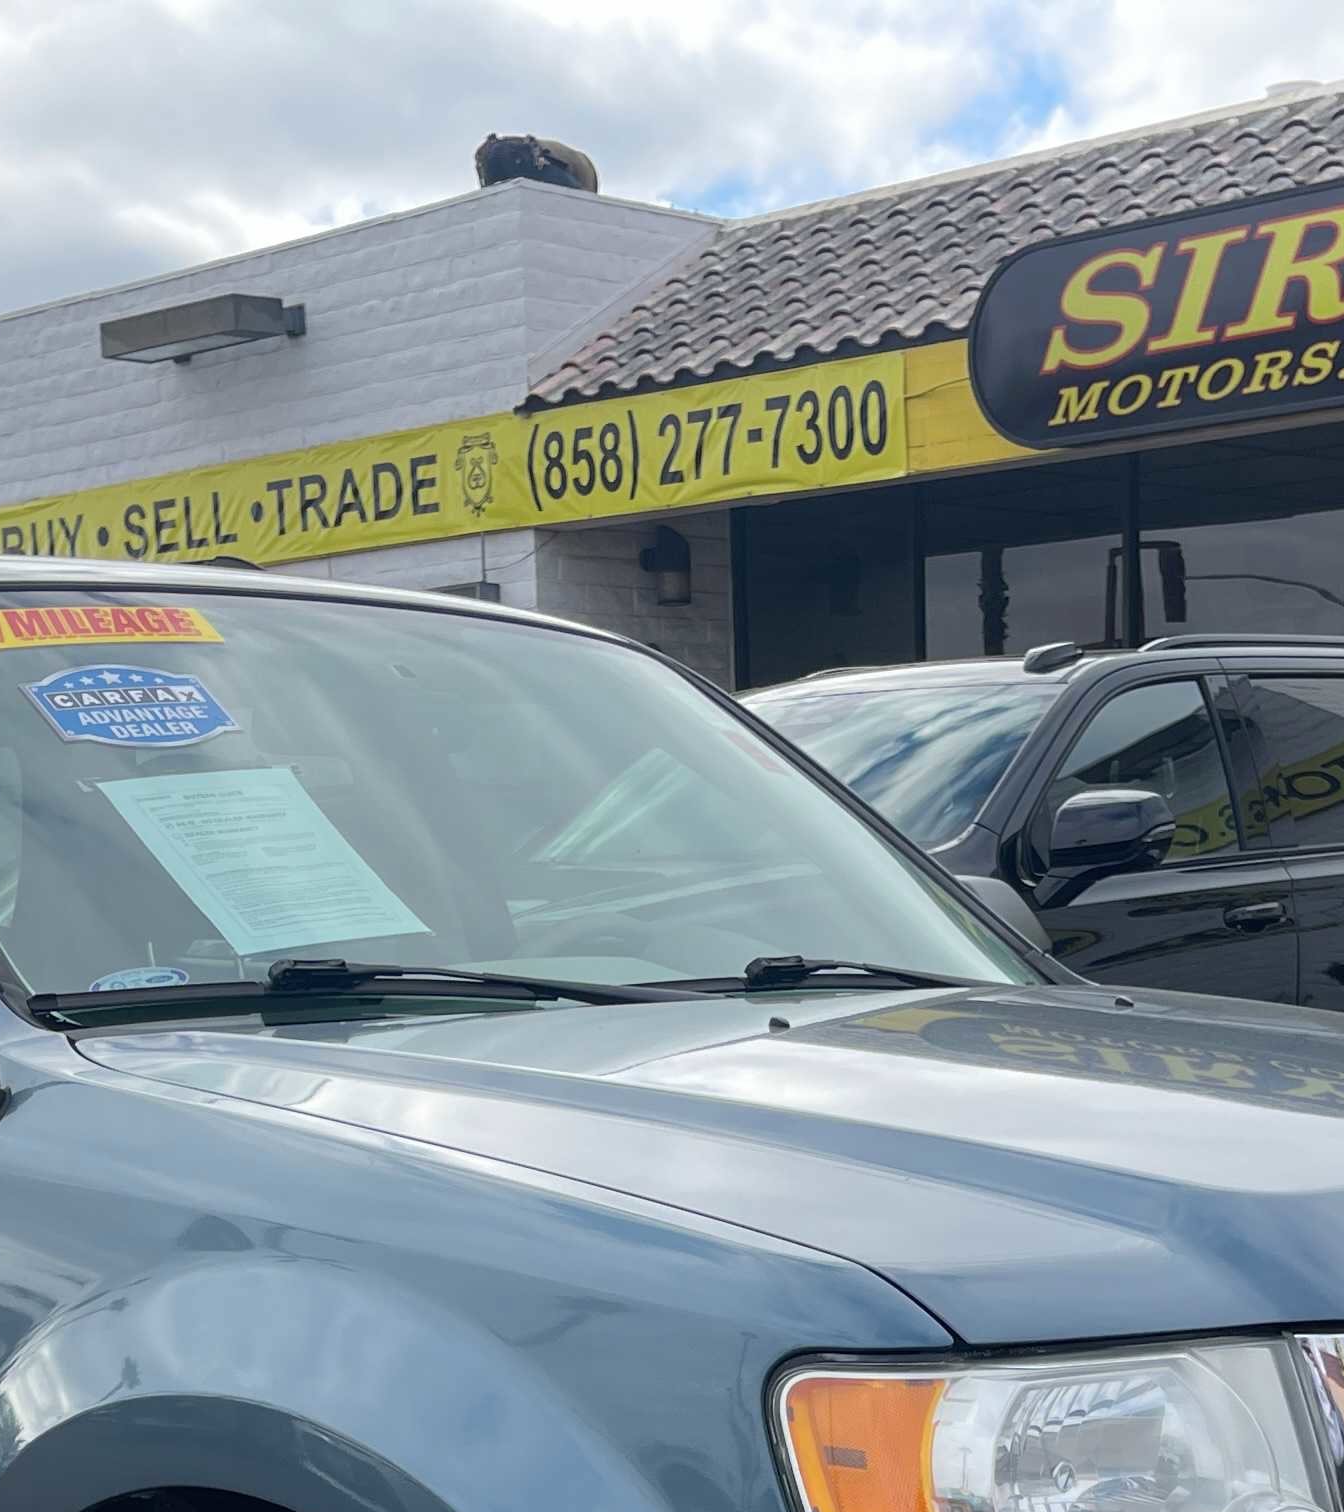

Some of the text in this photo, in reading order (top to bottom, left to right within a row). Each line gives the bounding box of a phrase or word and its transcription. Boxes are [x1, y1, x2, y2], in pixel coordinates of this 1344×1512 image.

[528, 380, 887, 511] (858) 277-7300
[2, 514, 84, 557] BUY
[124, 491, 238, 559] SELL
[267, 455, 440, 536] TRADE
[5, 607, 201, 640] MILEAGE
[48, 685, 206, 709] CARFAX
[78, 706, 209, 726] ADVANTAGE
[111, 721, 199, 739] DEALER
